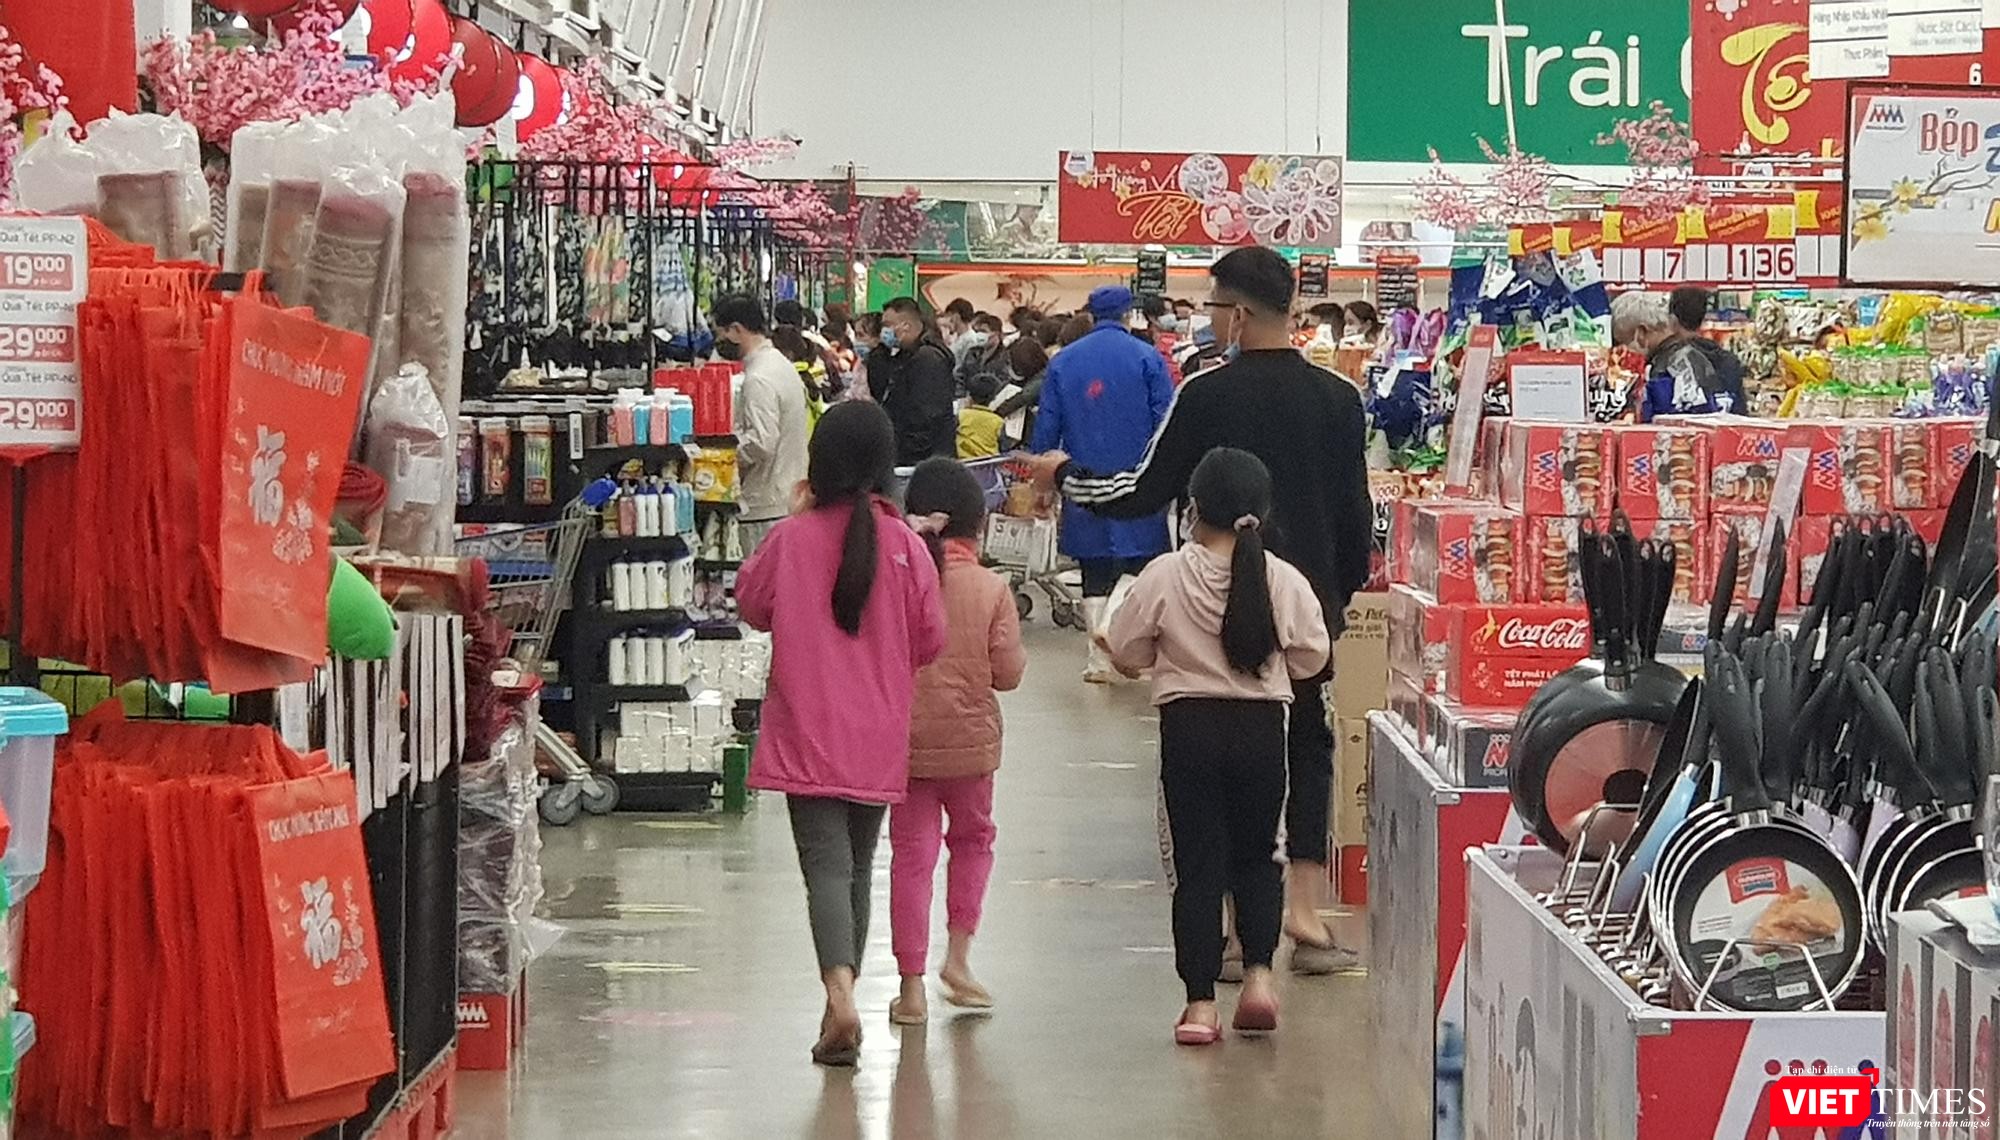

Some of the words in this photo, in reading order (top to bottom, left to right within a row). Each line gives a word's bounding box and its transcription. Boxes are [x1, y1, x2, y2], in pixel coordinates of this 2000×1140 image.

[1461, 25, 1640, 107] Trái
[1666, 252, 1681, 280] 7
[1526, 679, 1546, 688] PHÁ
